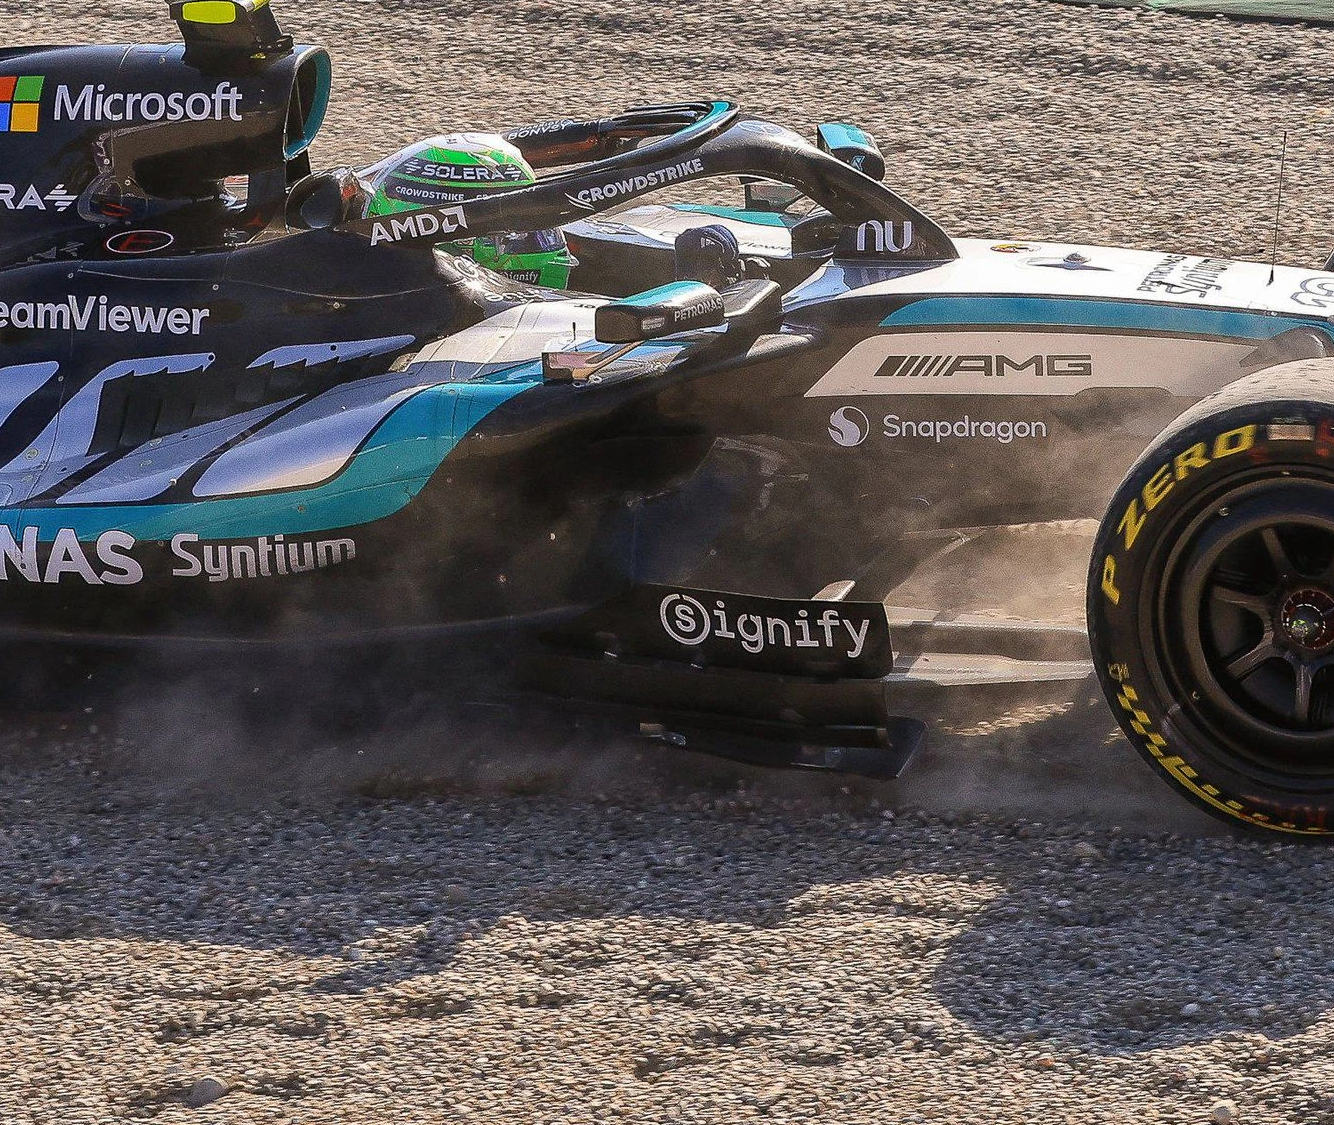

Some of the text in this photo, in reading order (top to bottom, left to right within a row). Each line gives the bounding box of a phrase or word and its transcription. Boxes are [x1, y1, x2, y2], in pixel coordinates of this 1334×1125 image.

[53, 81, 244, 123] Microsoft
[421, 164, 505, 180] SOLERA
[577, 158, 704, 202] CROWDSTRIKE
[395, 186, 464, 202] CROWDSTRIKE
[370, 213, 440, 246] AMD
[674, 298, 723, 323] PETRONAS
[948, 354, 1093, 377] AMG
[883, 414, 1047, 444] Snapdragon
[1100, 423, 1259, 606] P ZERO
[171, 533, 356, 583] Syntium
[659, 593, 870, 659] Signify
